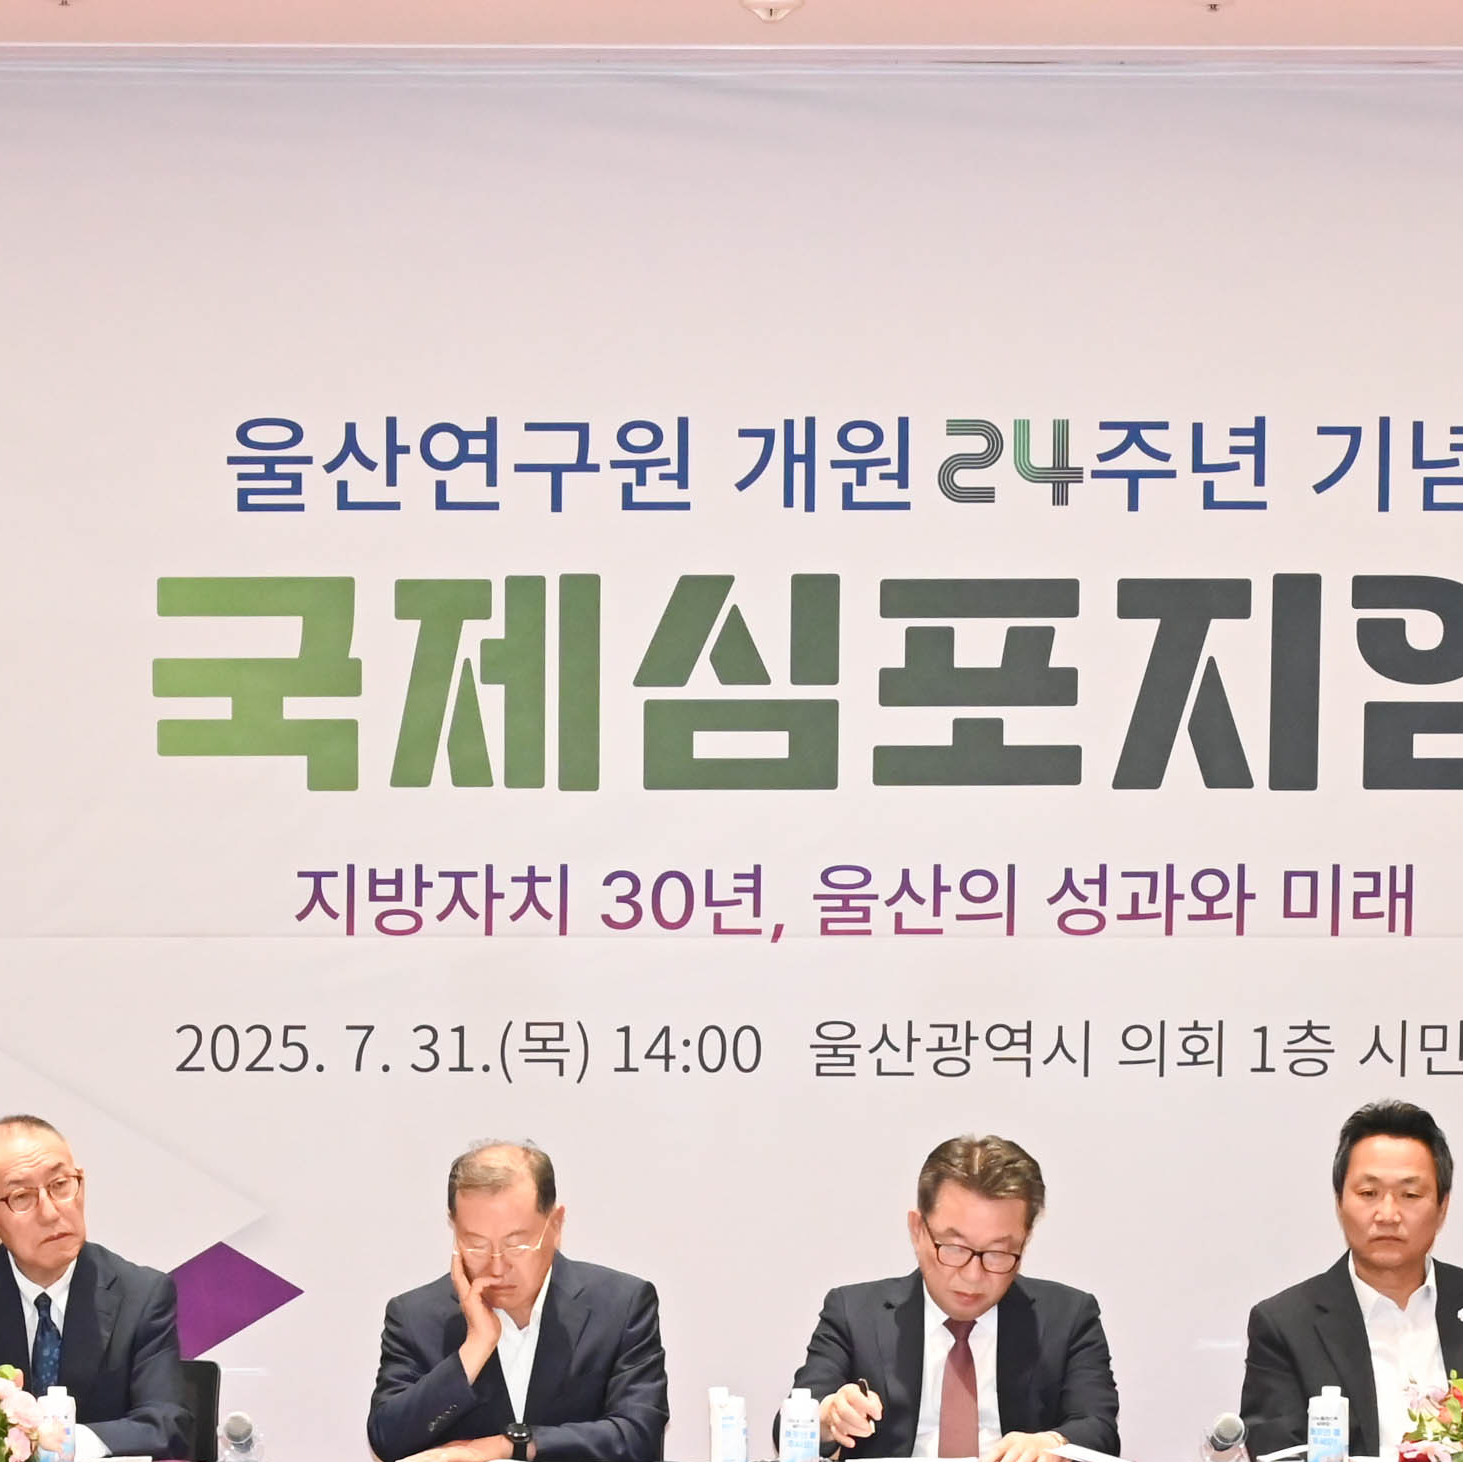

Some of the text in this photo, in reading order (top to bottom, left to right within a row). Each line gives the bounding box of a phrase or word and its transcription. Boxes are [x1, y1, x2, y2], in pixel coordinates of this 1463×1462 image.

[227, 416, 691, 512] 울산연구원
[295, 864, 1413, 943] 지방자치 30년, 울산의 성과와 미래
[176, 1024, 324, 1072] 2025.
[346, 1025, 390, 1072] 7.
[411, 1021, 588, 1083] 31.(목)
[614, 1025, 761, 1073] 14:00
[810, 1020, 1089, 1077] 울산광역시
[1119, 1020, 1223, 1077] 의회
[1251, 1020, 1334, 1077] 1층
